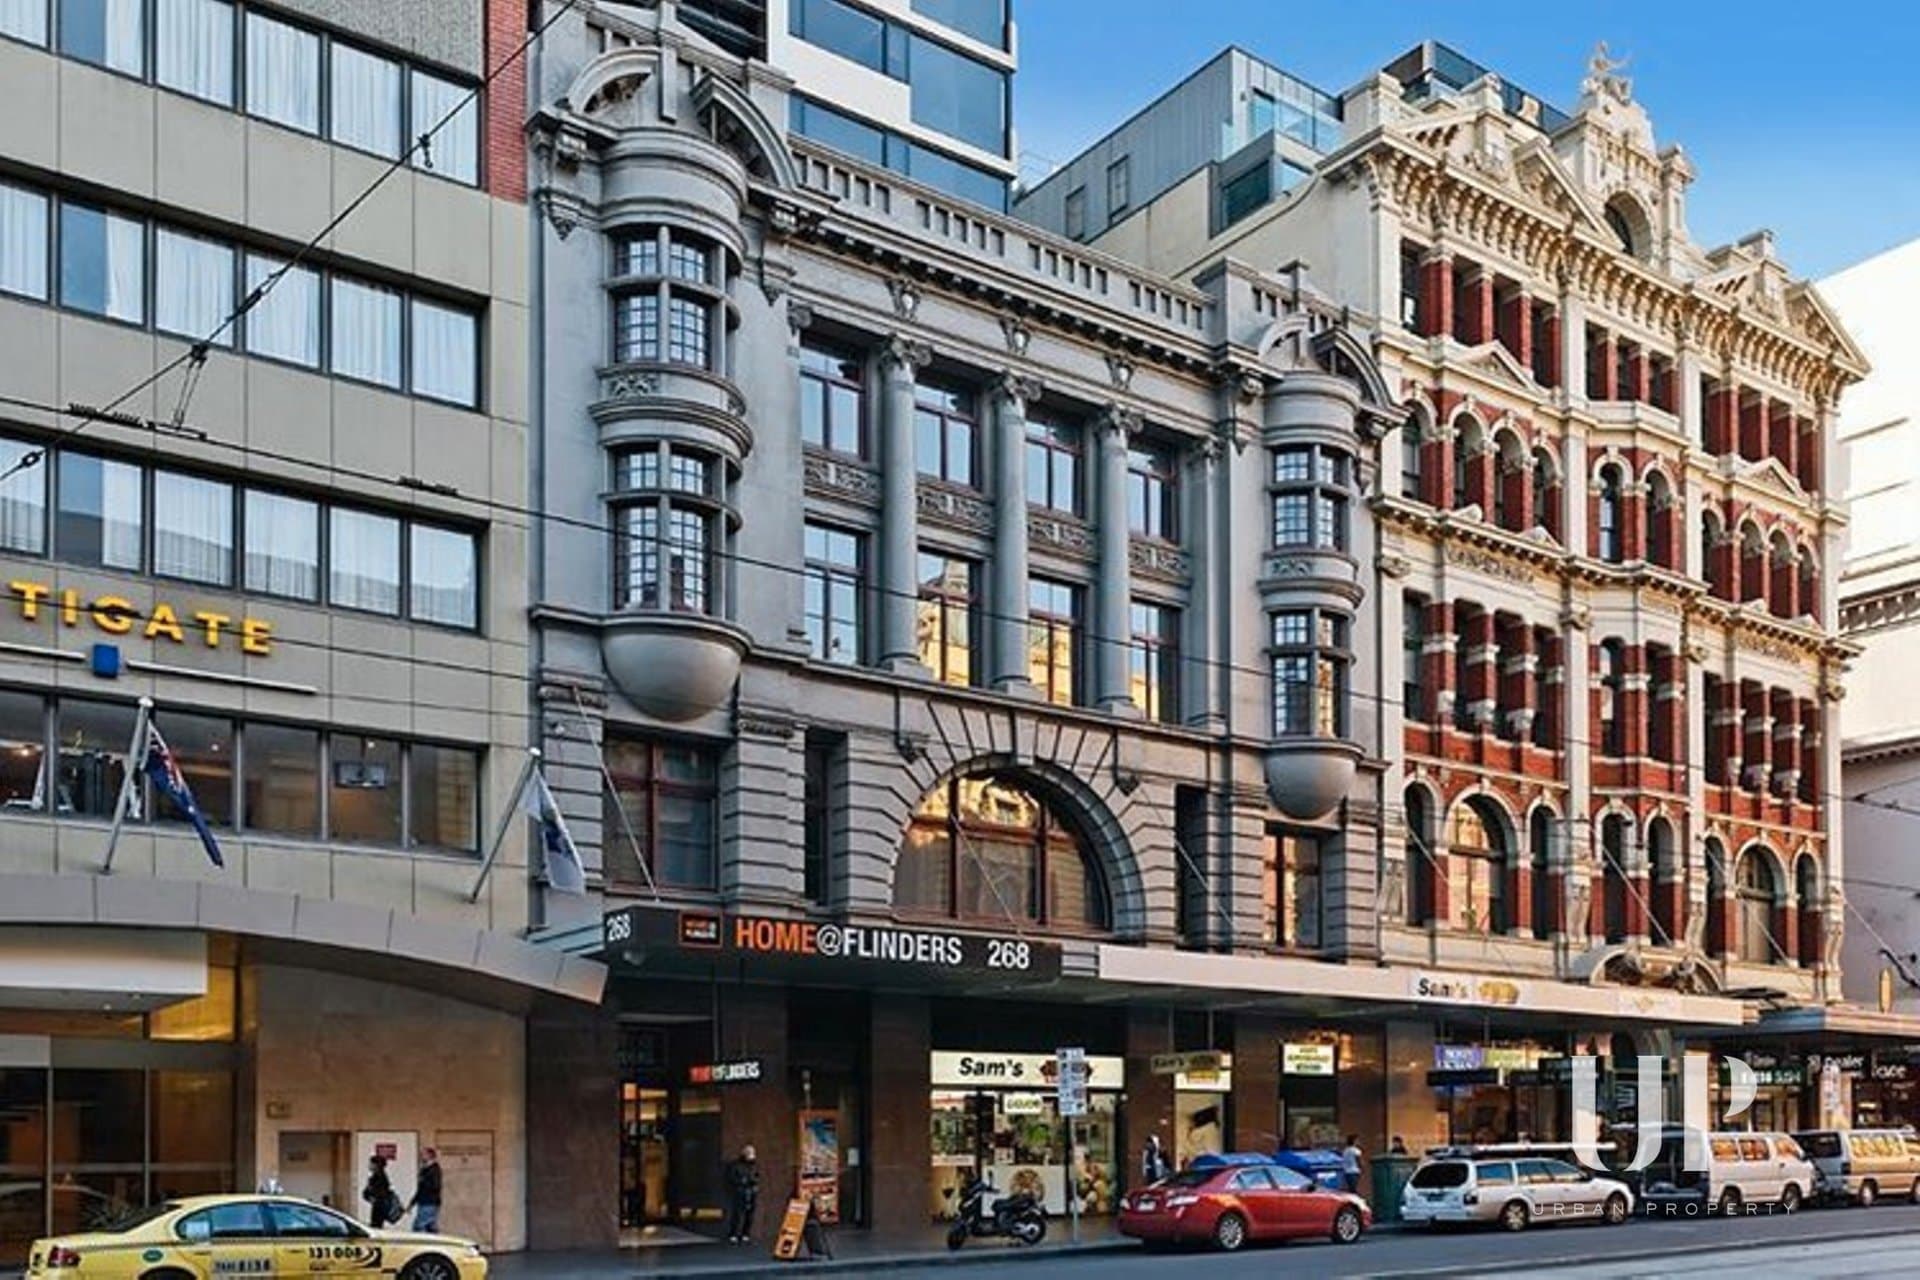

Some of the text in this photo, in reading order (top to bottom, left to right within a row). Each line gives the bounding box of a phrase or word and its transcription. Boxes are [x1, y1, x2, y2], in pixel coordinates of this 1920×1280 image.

[606, 912, 631, 942] 268
[735, 917, 963, 965] HOME@FLINDERS
[987, 939, 1031, 970] 268
[1418, 977, 1469, 998] Sam's
[958, 1056, 1024, 1078] Sam's
